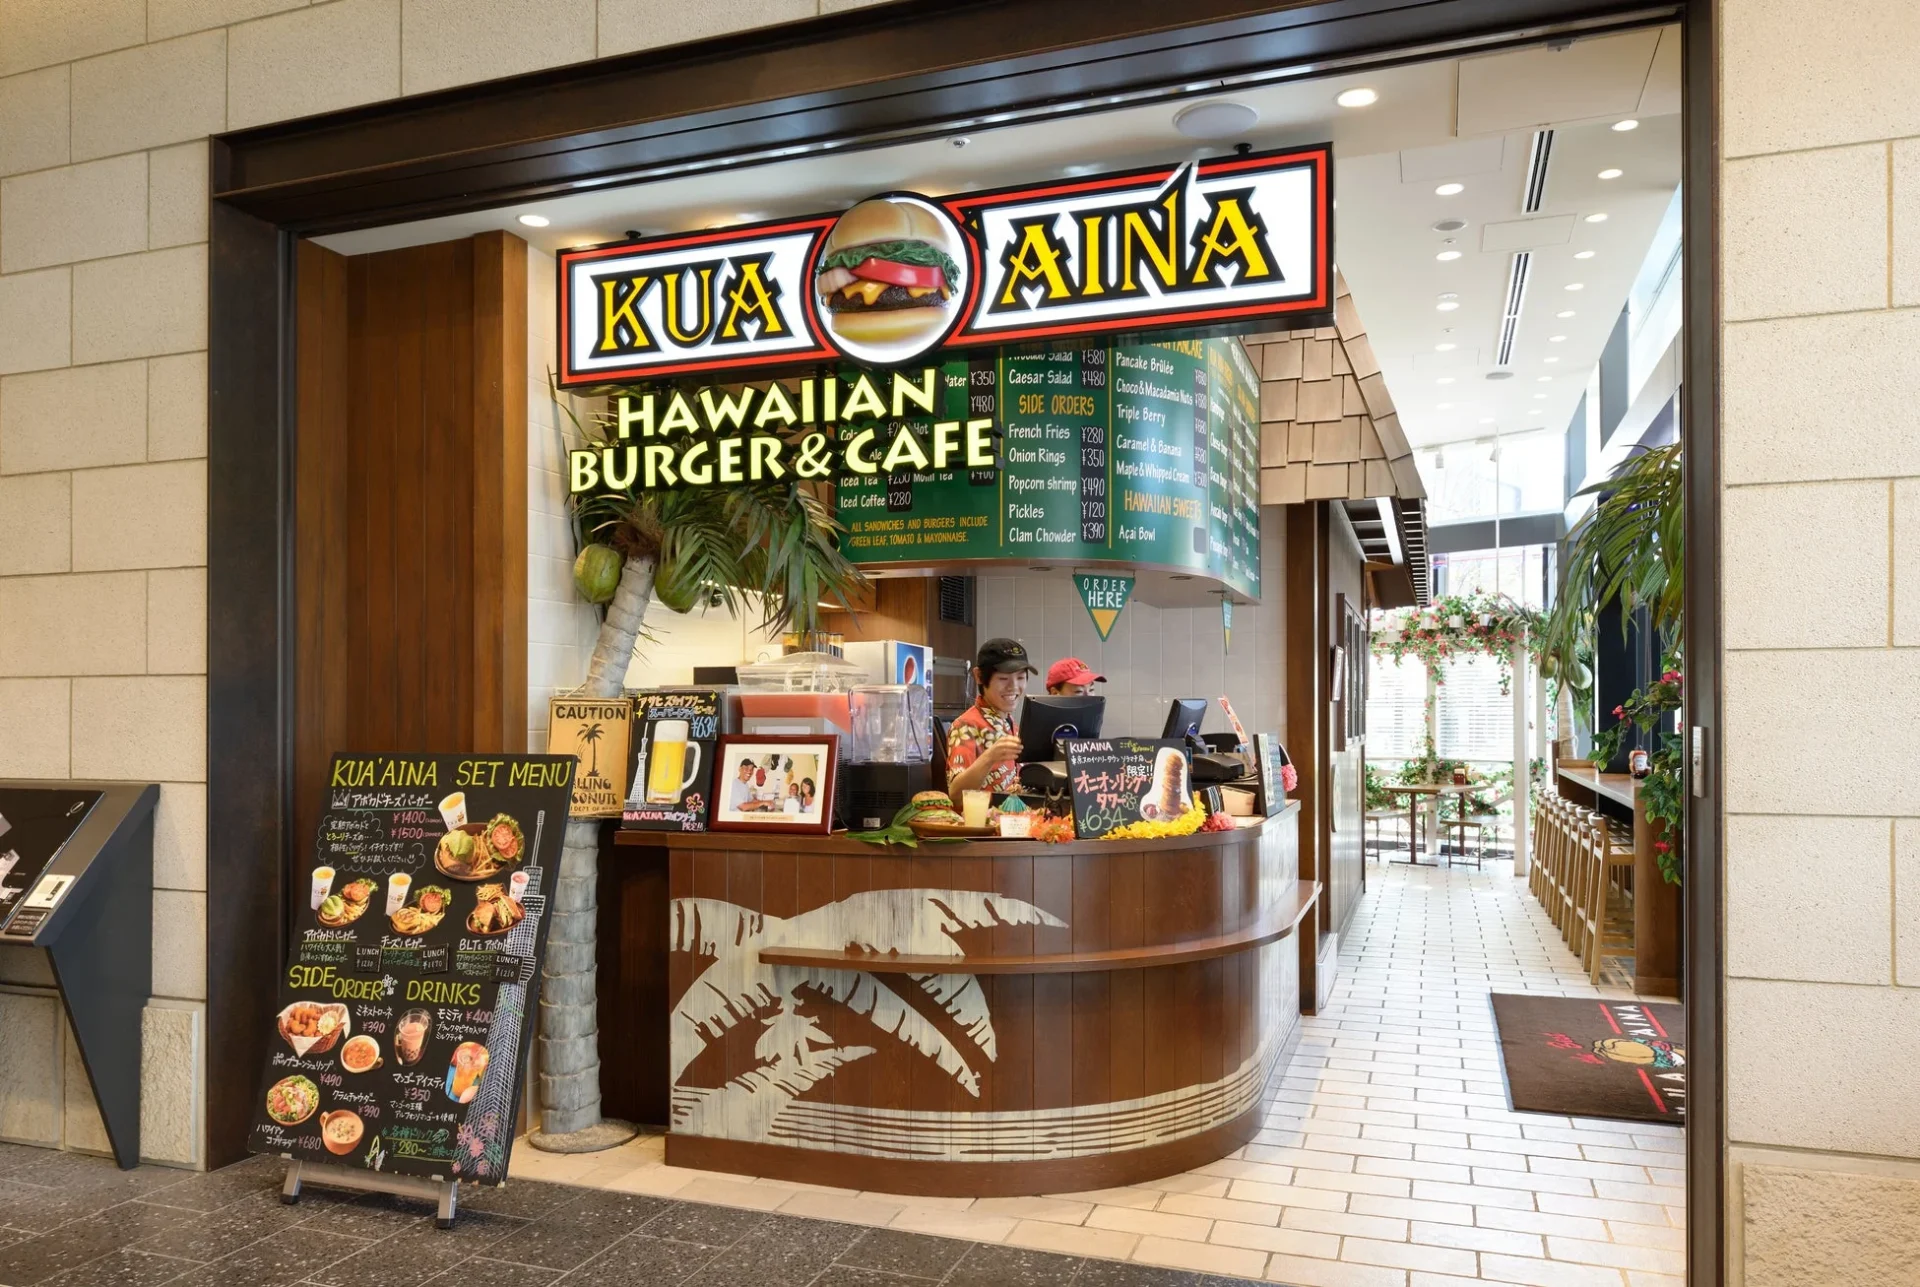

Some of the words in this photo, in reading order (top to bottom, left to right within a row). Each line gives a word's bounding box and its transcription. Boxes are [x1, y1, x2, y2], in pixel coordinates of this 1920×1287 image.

[597, 257, 788, 354] KUA
[1081, 349, 1105, 365] ¥580
[1116, 352, 1148, 370] Pancake
[1150, 357, 1175, 375] Brûlée
[971, 371, 995, 386] ¥350
[1008, 369, 1044, 384] Caesar
[1047, 370, 1072, 385] Salad
[1081, 370, 1105, 386] ¥480
[618, 367, 939, 439] HAWAIIAN
[971, 396, 995, 413] ¥480
[1019, 394, 1045, 414] SIDE
[1051, 394, 1095, 416] ORDERS
[1179, 389, 1193, 406] Nuts
[1116, 404, 1139, 424] Triple
[1142, 407, 1166, 427] Berry
[1008, 423, 1041, 439] French
[1045, 423, 1070, 439] Fries
[1081, 426, 1104, 443] ¥280
[1116, 434, 1149, 452] Caramel
[1150, 438, 1157, 453] &
[1158, 440, 1182, 457] Banana
[570, 435, 789, 494] BURGER
[795, 432, 832, 478] &
[844, 418, 995, 475] CAFE
[869, 449, 882, 461] Ale
[1008, 447, 1037, 462] Onion
[1038, 448, 1066, 466] Rings
[1081, 448, 1104, 467] ¥350
[1172, 469, 1190, 484] Cream
[1008, 474, 1044, 495] Popcorn
[1047, 476, 1077, 496] shrimp
[1081, 477, 1105, 497] ¥490
[840, 496, 858, 508] Iced
[860, 495, 886, 508] Coffee
[888, 491, 911, 506] ¥280
[1124, 489, 1171, 515] HAWAIIAN
[1173, 497, 1203, 522] SWEETS
[1008, 503, 1044, 518] Pickles
[1081, 501, 1105, 519] ¥120
[851, 522, 862, 533] ALL
[864, 520, 905, 532] SANDWICHES
[907, 519, 921, 530] AND
[923, 517, 955, 529] BURGERS
[959, 516, 988, 527] INCLUDE
[1009, 527, 1033, 542] Clam
[1035, 527, 1077, 543] Chowder
[1081, 522, 1105, 540] ¥390
[851, 536, 871, 547] GREEN
[890, 534, 915, 545] TOMATO
[1118, 524, 1137, 543] Açai
[1138, 526, 1156, 541] Bowl
[1083, 578, 1126, 592] ORDER
[1088, 590, 1123, 608] HERE
[555, 706, 626, 720] CAUTION
[1069, 741, 1113, 754] KUA'AINA
[331, 757, 438, 787] KUA'AINA
[456, 760, 504, 788] SET
[508, 760, 572, 788] MENU
[1126, 764, 1154, 777] 限定!!
[1074, 770, 1147, 794] オニオンリング
[352, 793, 433, 808] アボカドチーズバーガー
[1096, 793, 1127, 809] タワー
[393, 810, 426, 824] ¥1400
[1079, 805, 1128, 833] ¥634
[391, 827, 424, 839] ¥1500
[304, 929, 358, 942] アボカドバーガー
[381, 935, 427, 949] チーズバーガー
[356, 947, 380, 956] LUNCH
[422, 948, 445, 958] LUNCH
[496, 955, 520, 965] LUNCH
[289, 965, 336, 989] SIDE
[332, 977, 383, 1001] ORDER
[406, 980, 481, 1006] DRINKS
[356, 1004, 393, 1018] ミネストローネ
[437, 1008, 463, 1022] モミティ
[466, 1009, 493, 1023] ¥400
[361, 1020, 386, 1034] ¥390
[320, 1073, 342, 1087] ¥490
[393, 1072, 445, 1090] マンゴーアイスティ
[332, 1089, 376, 1104] クラムチャウダー
[404, 1087, 431, 1102] ¥350
[358, 1104, 380, 1118] ¥390
[256, 1124, 285, 1135] ハワイアン
[298, 1135, 321, 1150] ¥680
